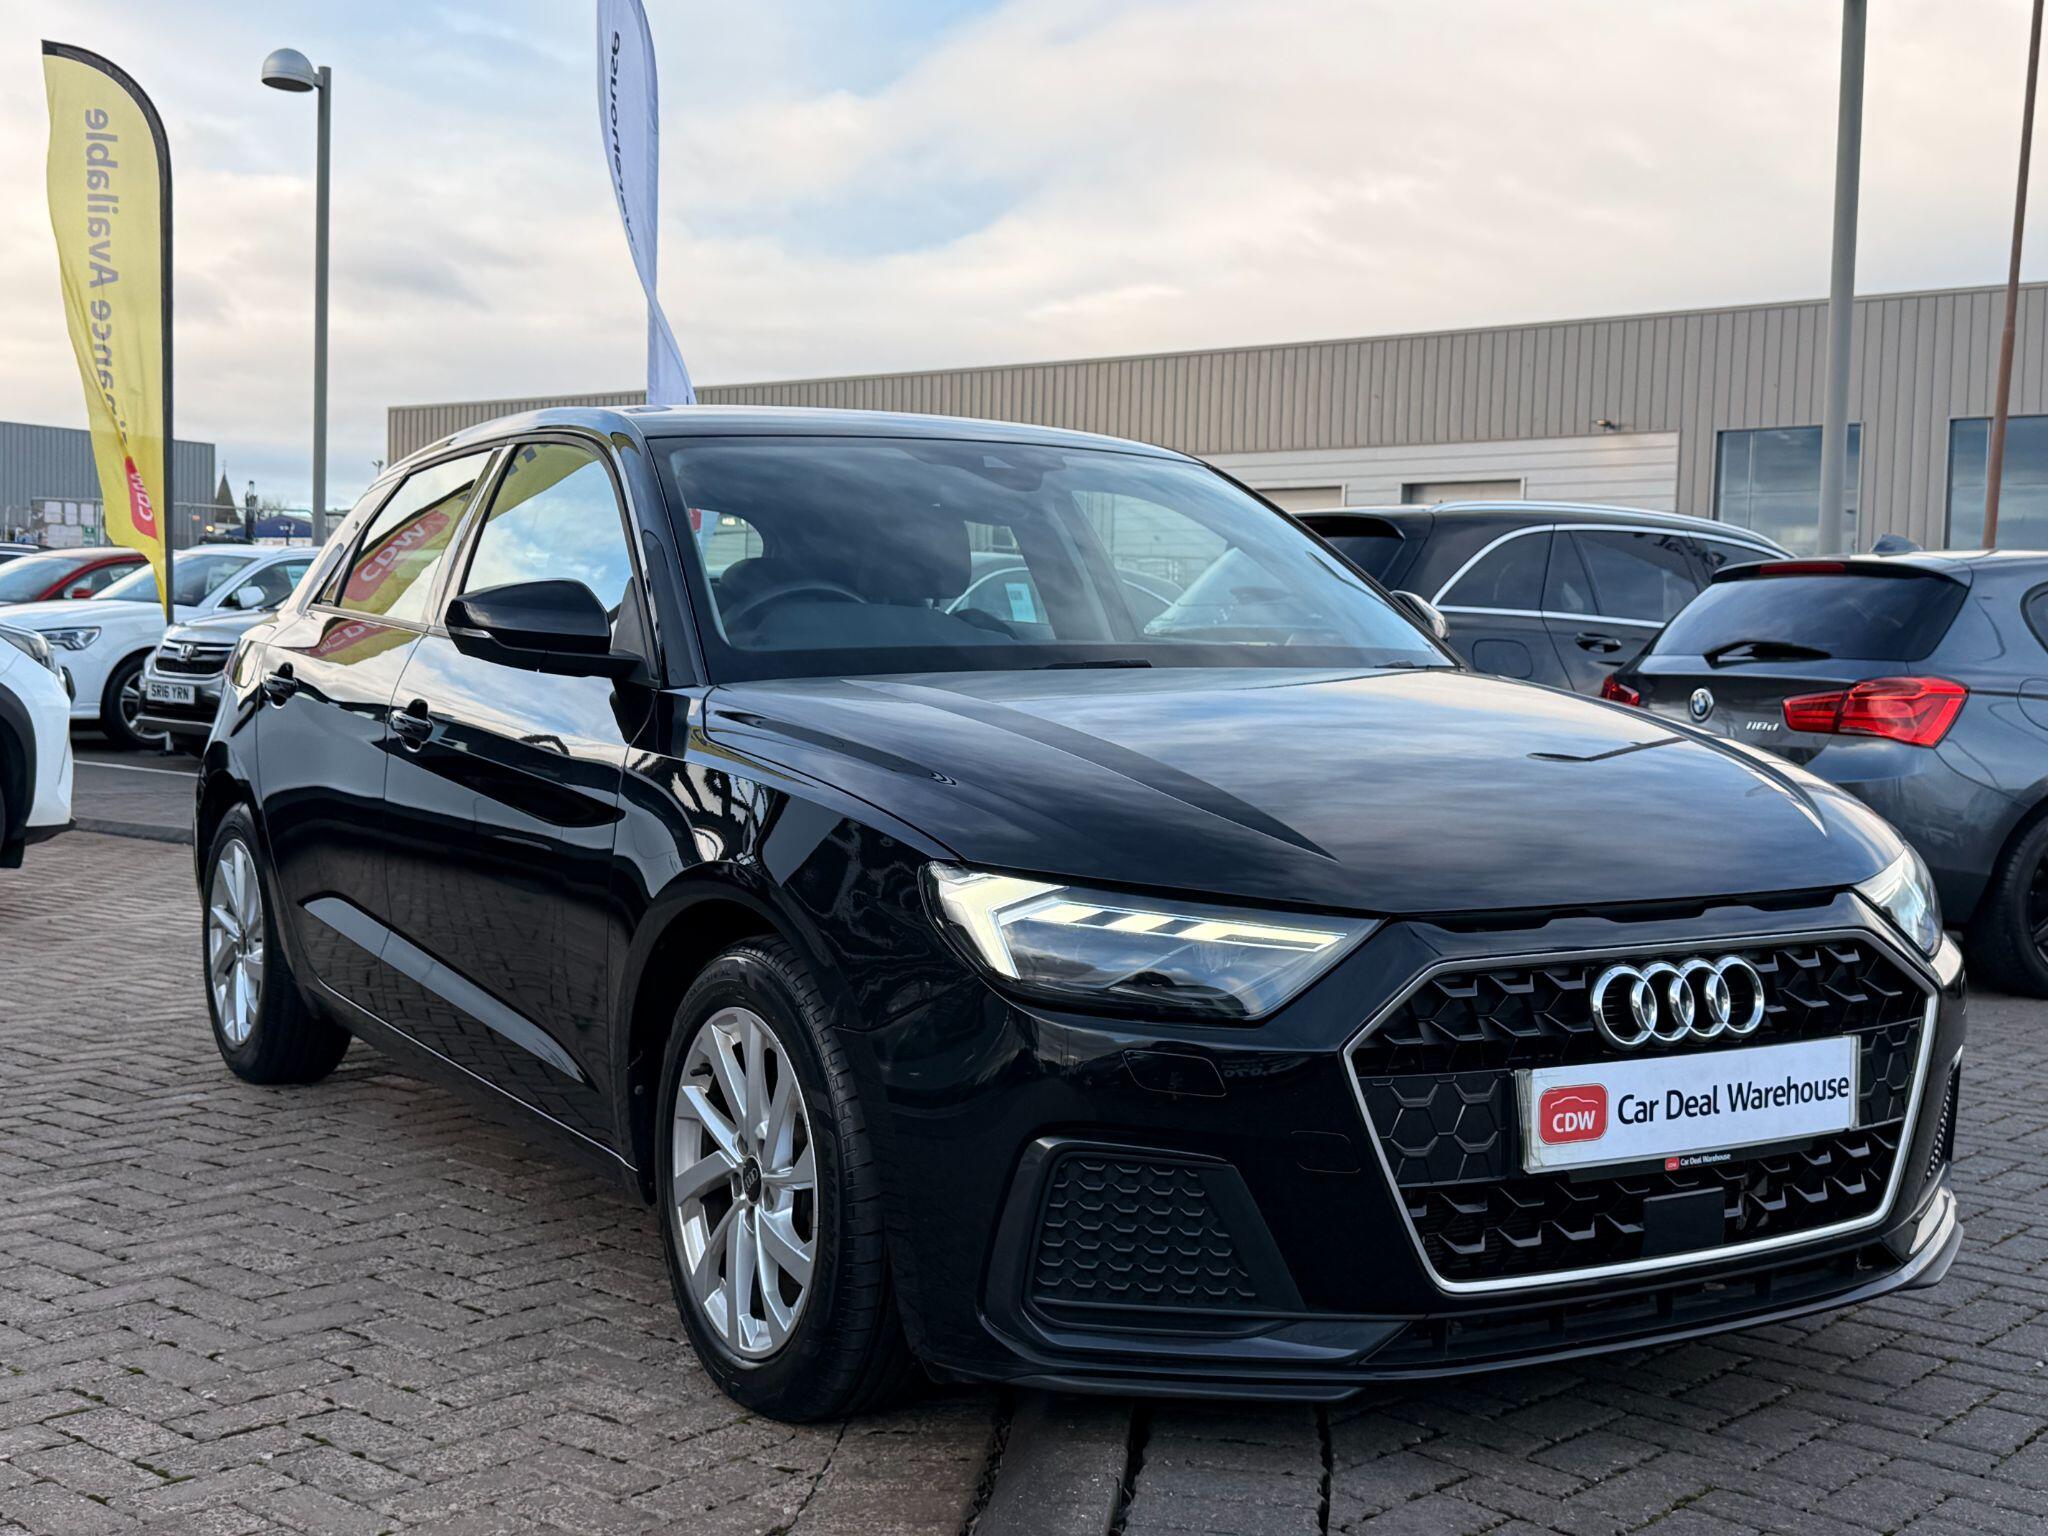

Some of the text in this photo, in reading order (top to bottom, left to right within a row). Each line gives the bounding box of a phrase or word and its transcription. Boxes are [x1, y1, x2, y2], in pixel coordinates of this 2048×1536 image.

[361, 523, 425, 582] CDW
[151, 684, 189, 700] SR16 YRN
[1617, 1076, 1850, 1125] Car Deal Warehouse
[1552, 1109, 1597, 1134] CDW
